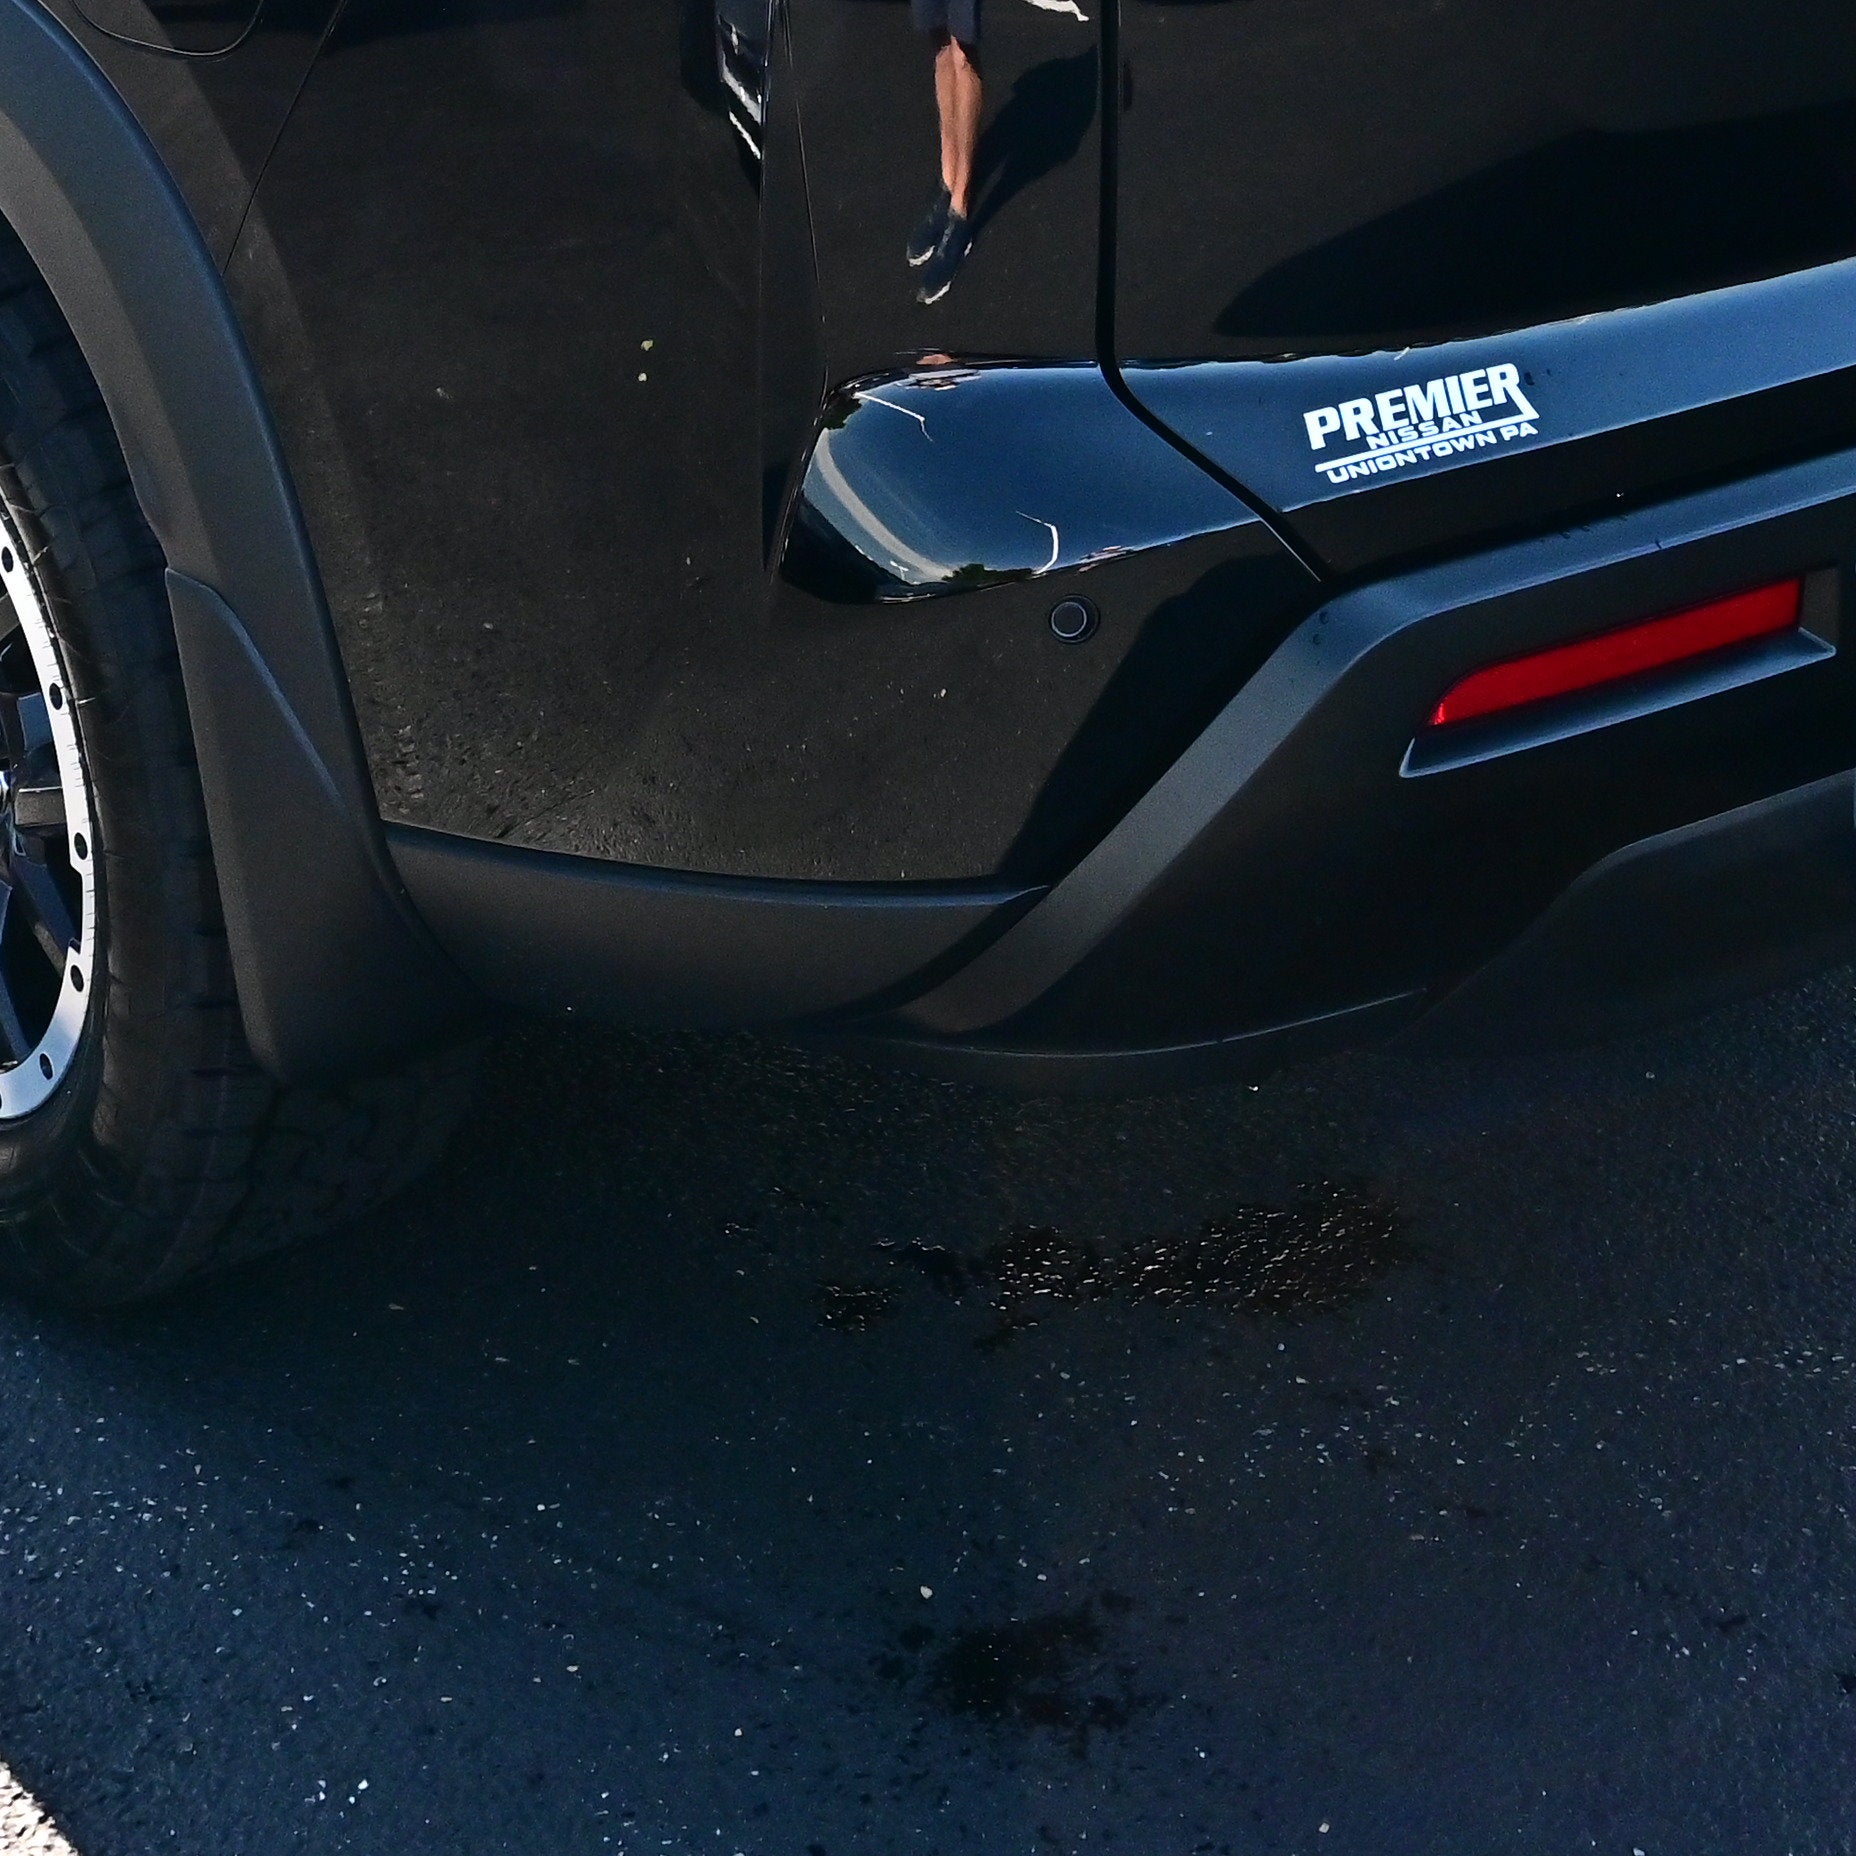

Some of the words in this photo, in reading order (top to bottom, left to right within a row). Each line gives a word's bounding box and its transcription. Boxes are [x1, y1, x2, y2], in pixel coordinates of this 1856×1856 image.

[1303, 363, 1540, 450] PREMIER
[1367, 411, 1483, 450] NISSAN
[1326, 429, 1498, 484] UNIONTOWN
[1502, 421, 1540, 442] PA
